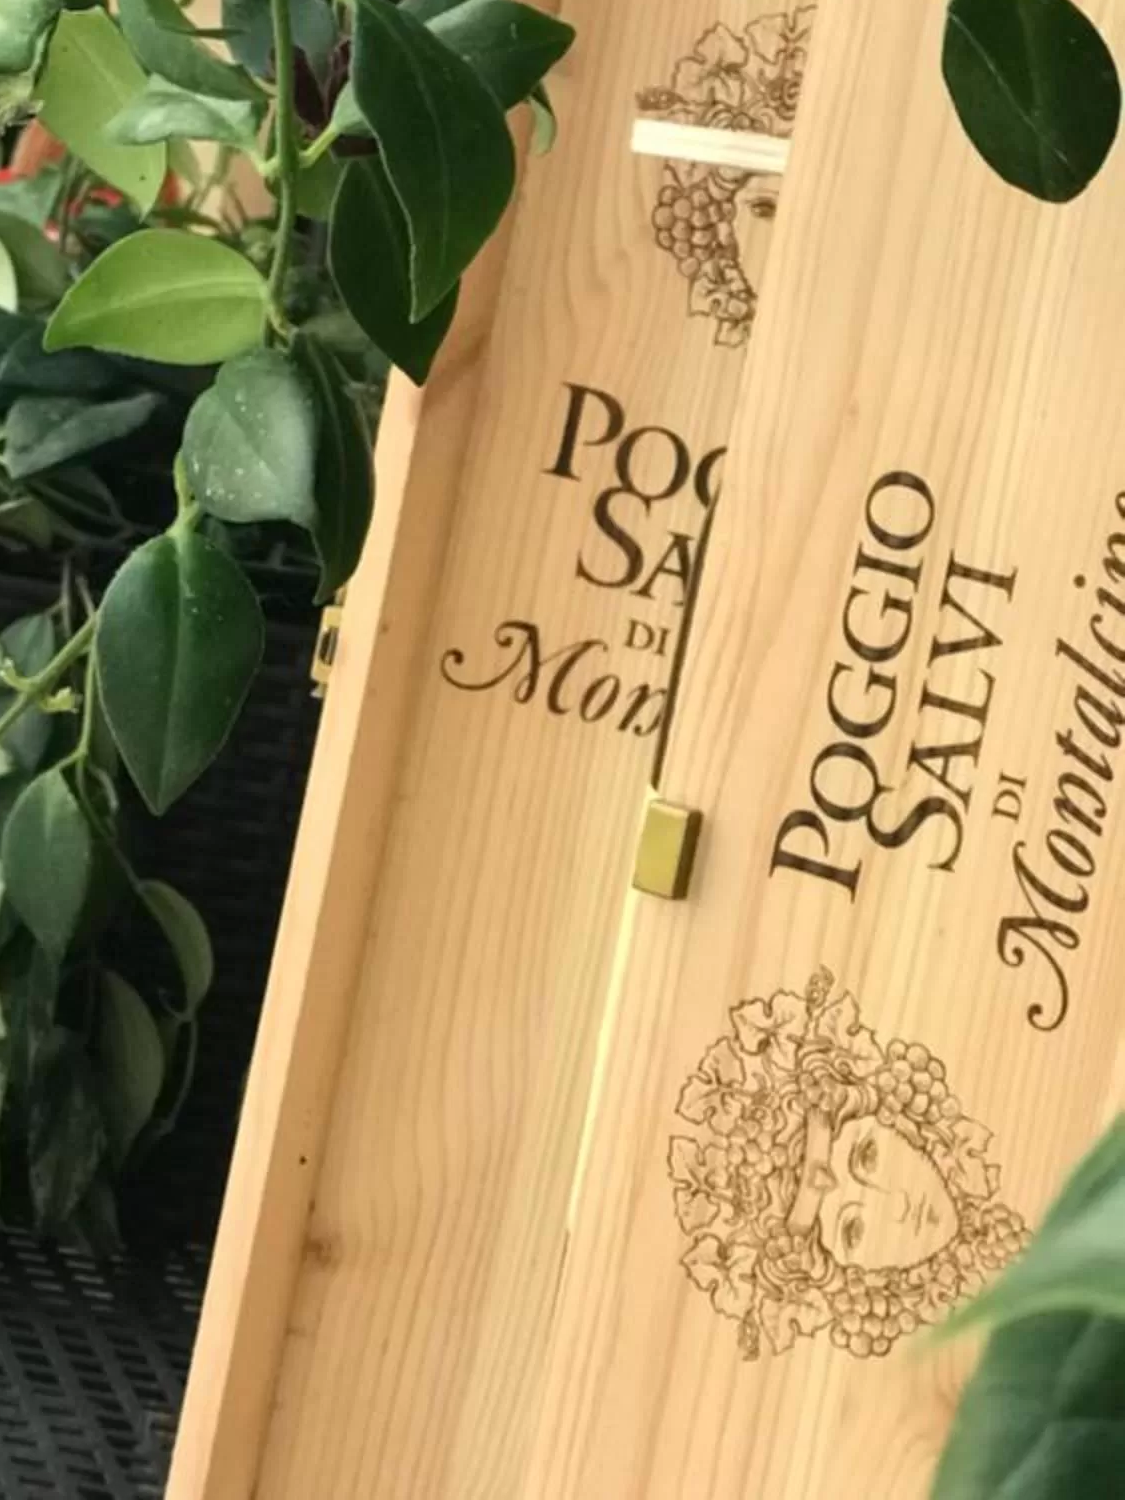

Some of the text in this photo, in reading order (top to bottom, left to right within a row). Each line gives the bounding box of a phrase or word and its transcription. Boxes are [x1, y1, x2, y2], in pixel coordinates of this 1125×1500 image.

[623, 615, 672, 657] DI
[769, 470, 936, 905] POGGIO
[865, 548, 1019, 874] SALVI
[991, 768, 1028, 824] DI
[996, 490, 1125, 1031] Montalci
